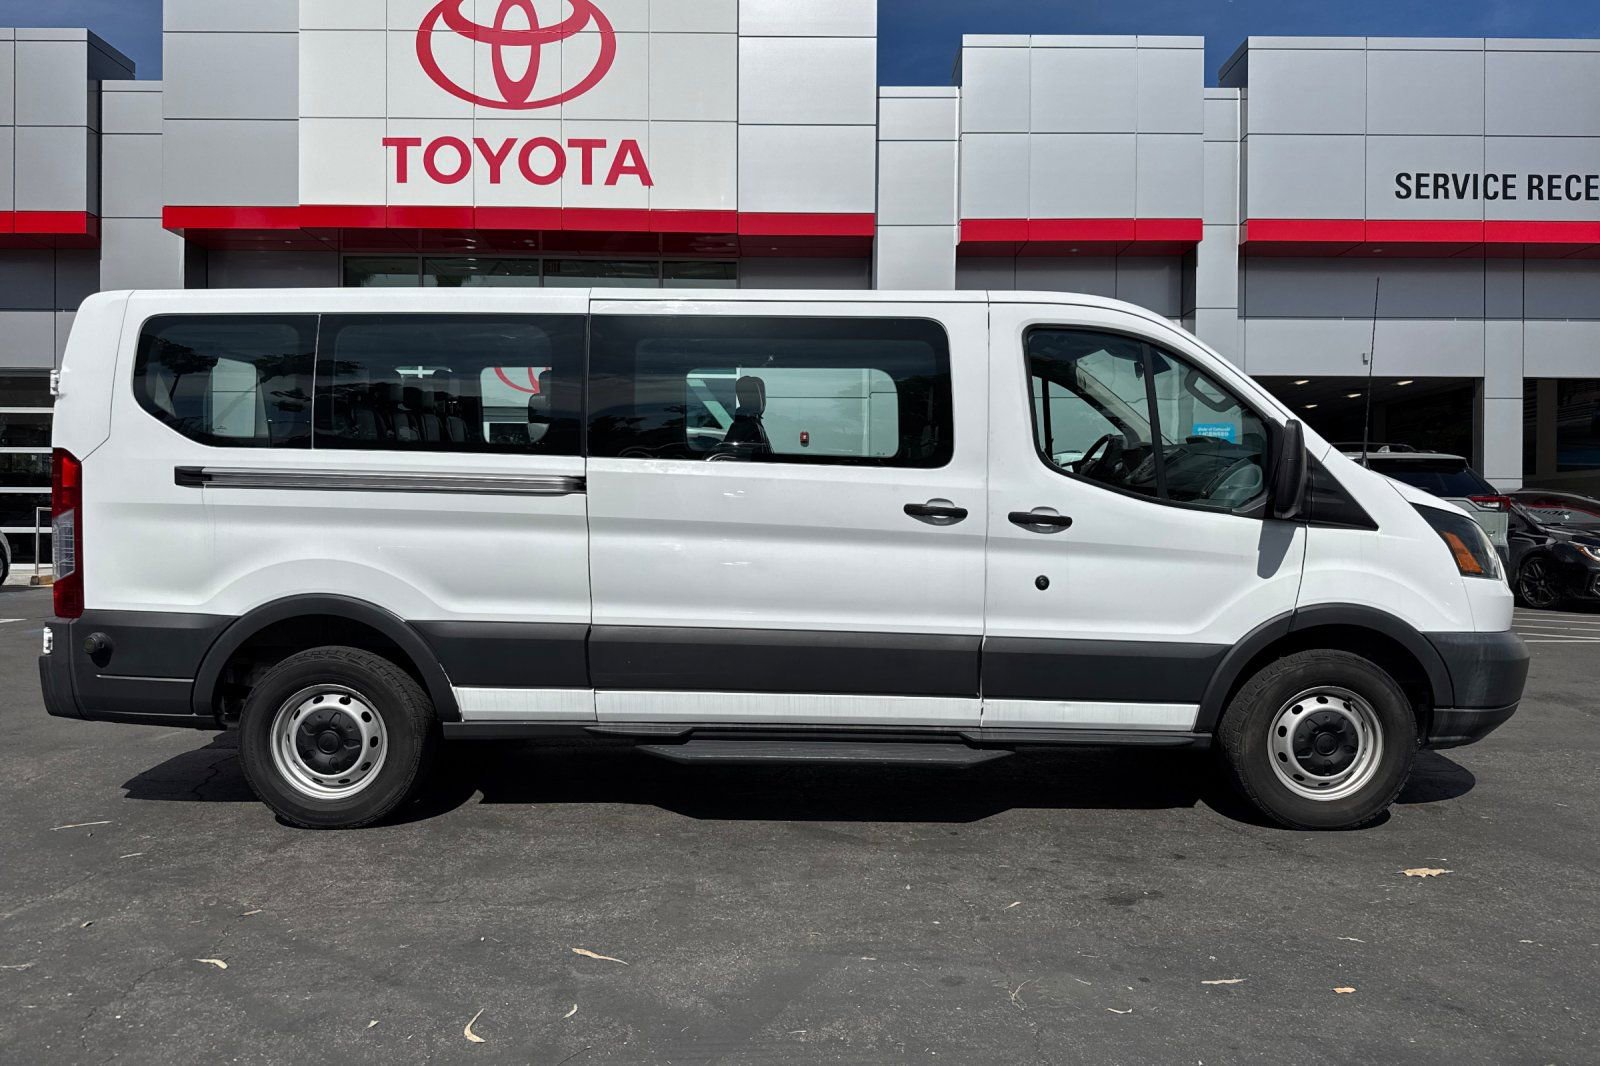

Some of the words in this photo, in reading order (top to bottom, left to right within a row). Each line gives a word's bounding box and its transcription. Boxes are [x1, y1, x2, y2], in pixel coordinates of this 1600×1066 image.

[382, 136, 655, 186] TOYOTA
[1395, 172, 1517, 200] SERVICE
[1527, 174, 1600, 201] RECE
